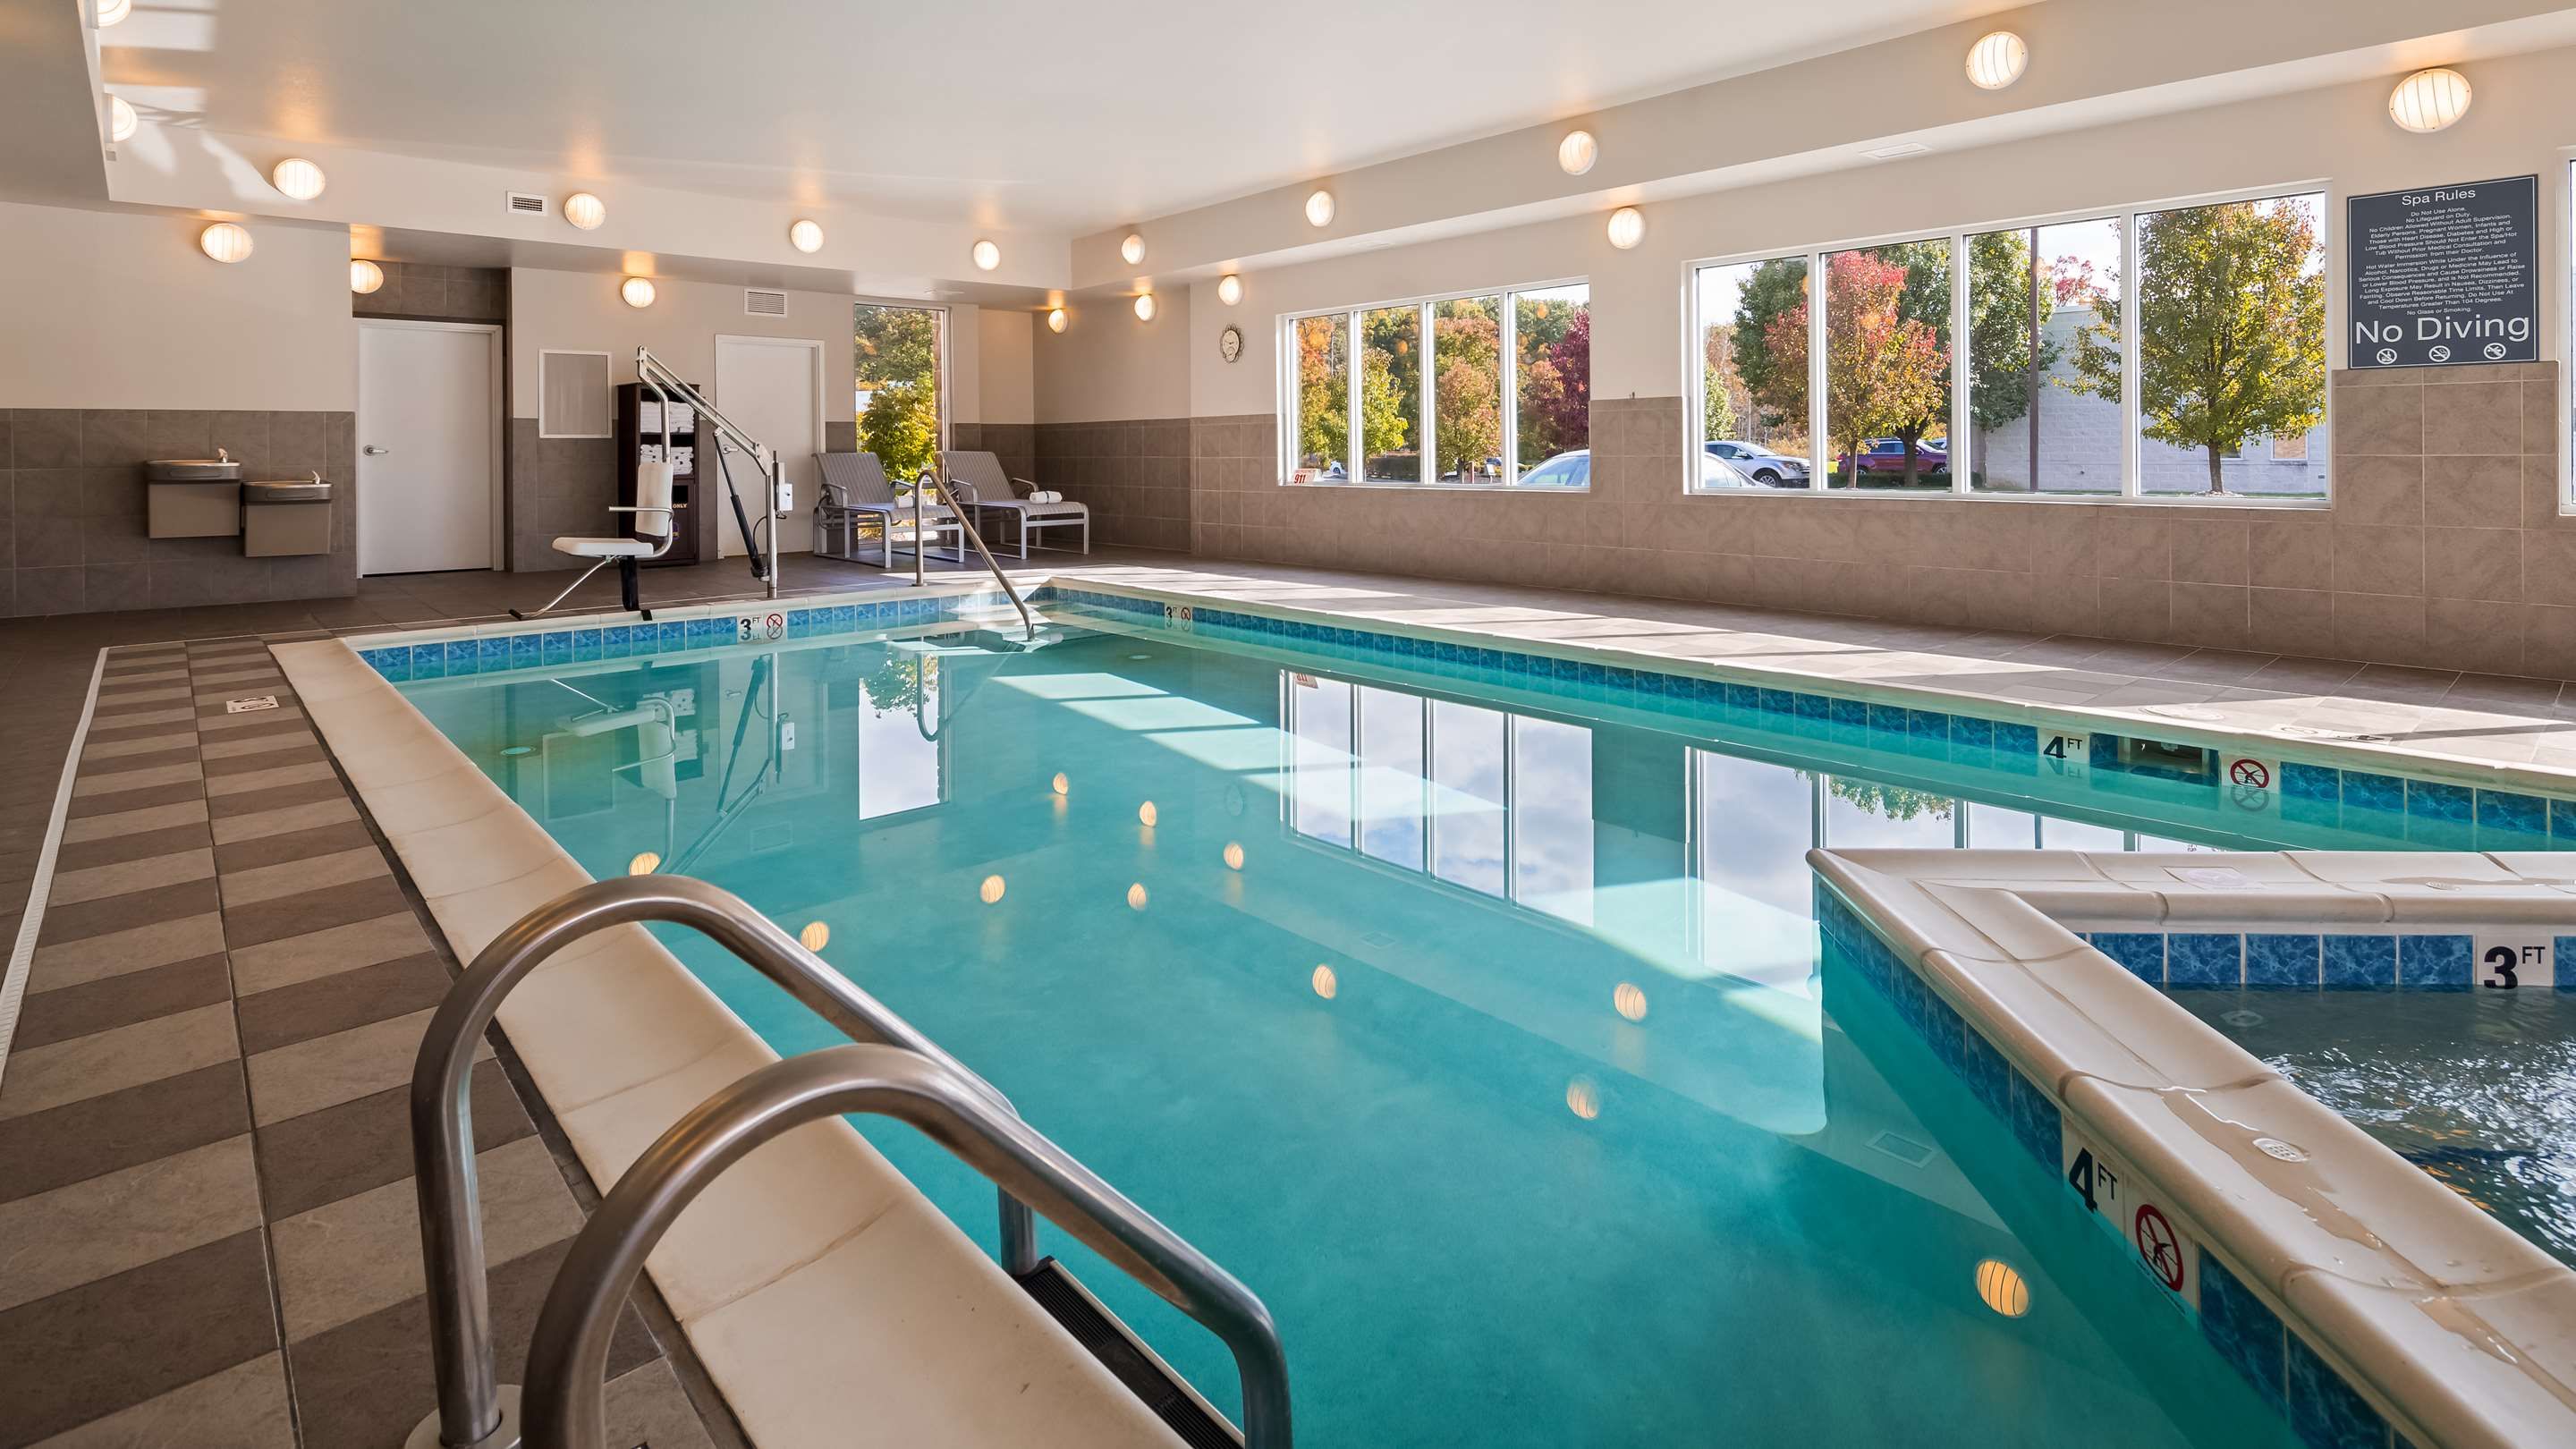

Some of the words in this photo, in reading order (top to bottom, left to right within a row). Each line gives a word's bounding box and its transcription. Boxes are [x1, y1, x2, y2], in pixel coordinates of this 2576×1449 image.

[2402, 195, 2430, 206] Spa
[2435, 190, 2476, 201] Rules
[2356, 320, 2402, 343] No
[2418, 314, 2529, 342] Diving
[1294, 474, 1306, 484] 911
[1166, 606, 1173, 618] 3
[741, 619, 751, 631] 3
[2044, 736, 2067, 758] 4
[2068, 738, 2082, 750] FT
[2484, 946, 2518, 989] 3
[2522, 946, 2546, 964] FT
[2069, 1148, 2097, 1213] 4
[2097, 1162, 2118, 1200] FT
